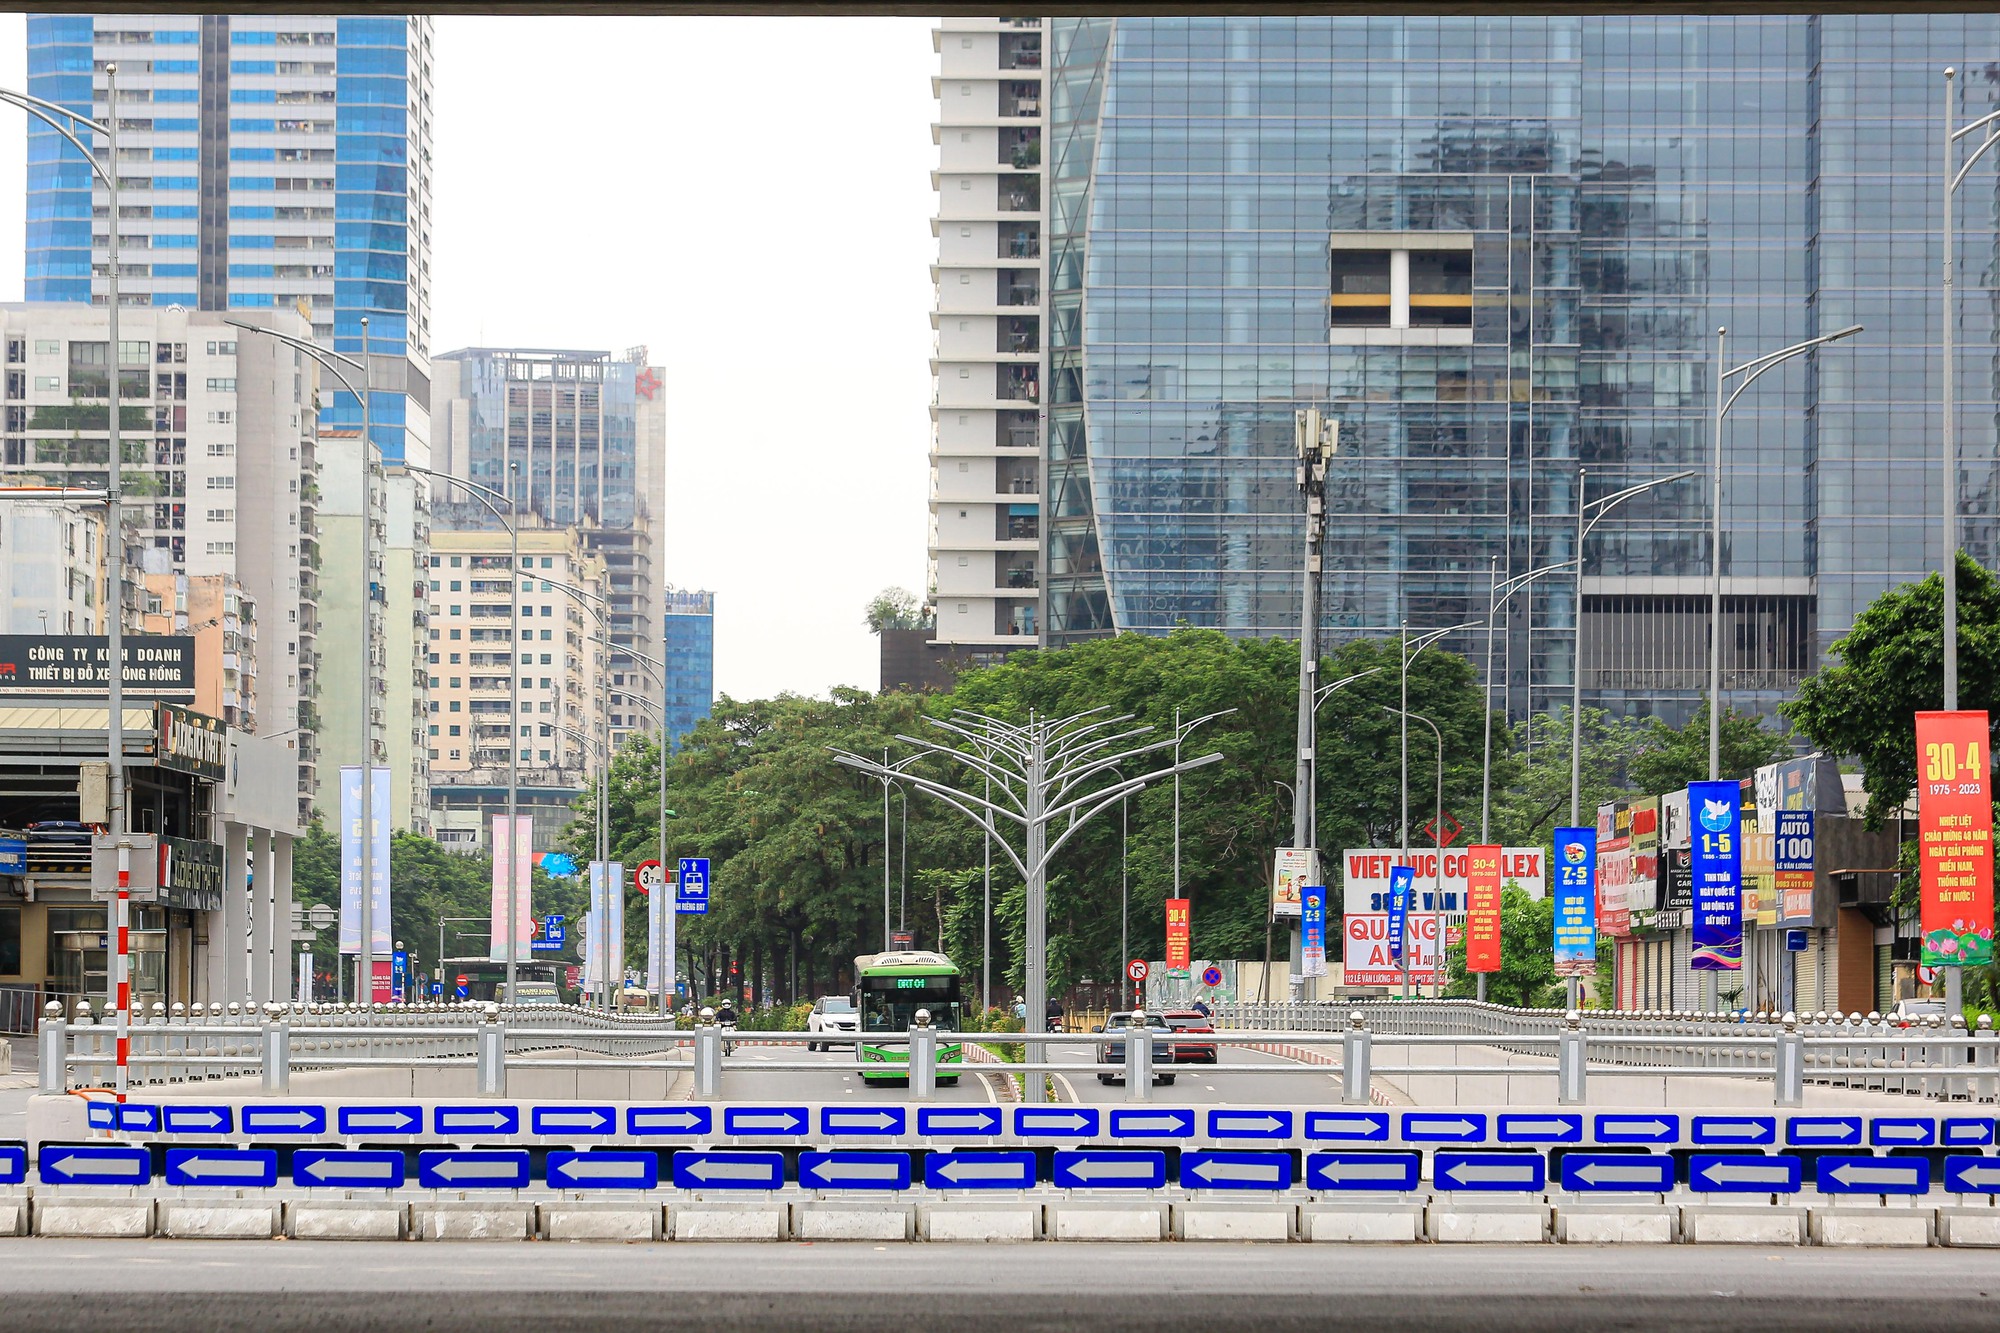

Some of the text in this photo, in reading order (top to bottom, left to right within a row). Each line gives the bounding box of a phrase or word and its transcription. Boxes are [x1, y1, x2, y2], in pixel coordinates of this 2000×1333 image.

[29, 645, 182, 662] CÔNG TY KIH DOANH
[28, 663, 60, 680] THIẾT
[63, 667, 74, 683] BỊ
[78, 664, 94, 680] ĐỖ
[96, 668, 110, 680] XE
[121, 667, 146, 680] ÔNG
[150, 664, 182, 680] HỒNG
[1929, 784, 1950, 795] 1975
[1959, 784, 1980, 794] 2023
[1780, 822, 1810, 835] AUTO
[1939, 816, 1972, 828] NHIỆT LIỆT
[1924, 830, 1942, 842] CHÀO
[1963, 832, 1972, 840] 48
[1973, 830, 1987, 840] NĂM
[1702, 834, 1730, 853] 1-5
[1743, 836, 1774, 860] 110
[1777, 838, 1812, 859] 100
[1929, 846, 1946, 858] NGÀY
[1962, 844, 1984, 857] PHÓNG
[1349, 856, 1391, 878] VIET
[1444, 855, 1540, 878] COLEX
[1473, 859, 1496, 869] 30-4
[1939, 860, 1956, 872] MIỀN
[1562, 867, 1587, 878] 7-5
[1938, 874, 1976, 888] THỐNG NHẤT
[1169, 910, 1186, 922] 30-4
[1350, 919, 1440, 940] QUNG
[1368, 945, 1420, 965] AH
[1423, 955, 1442, 966] AUO
[914, 979, 925, 988] 01
[1345, 974, 1353, 983] 112
